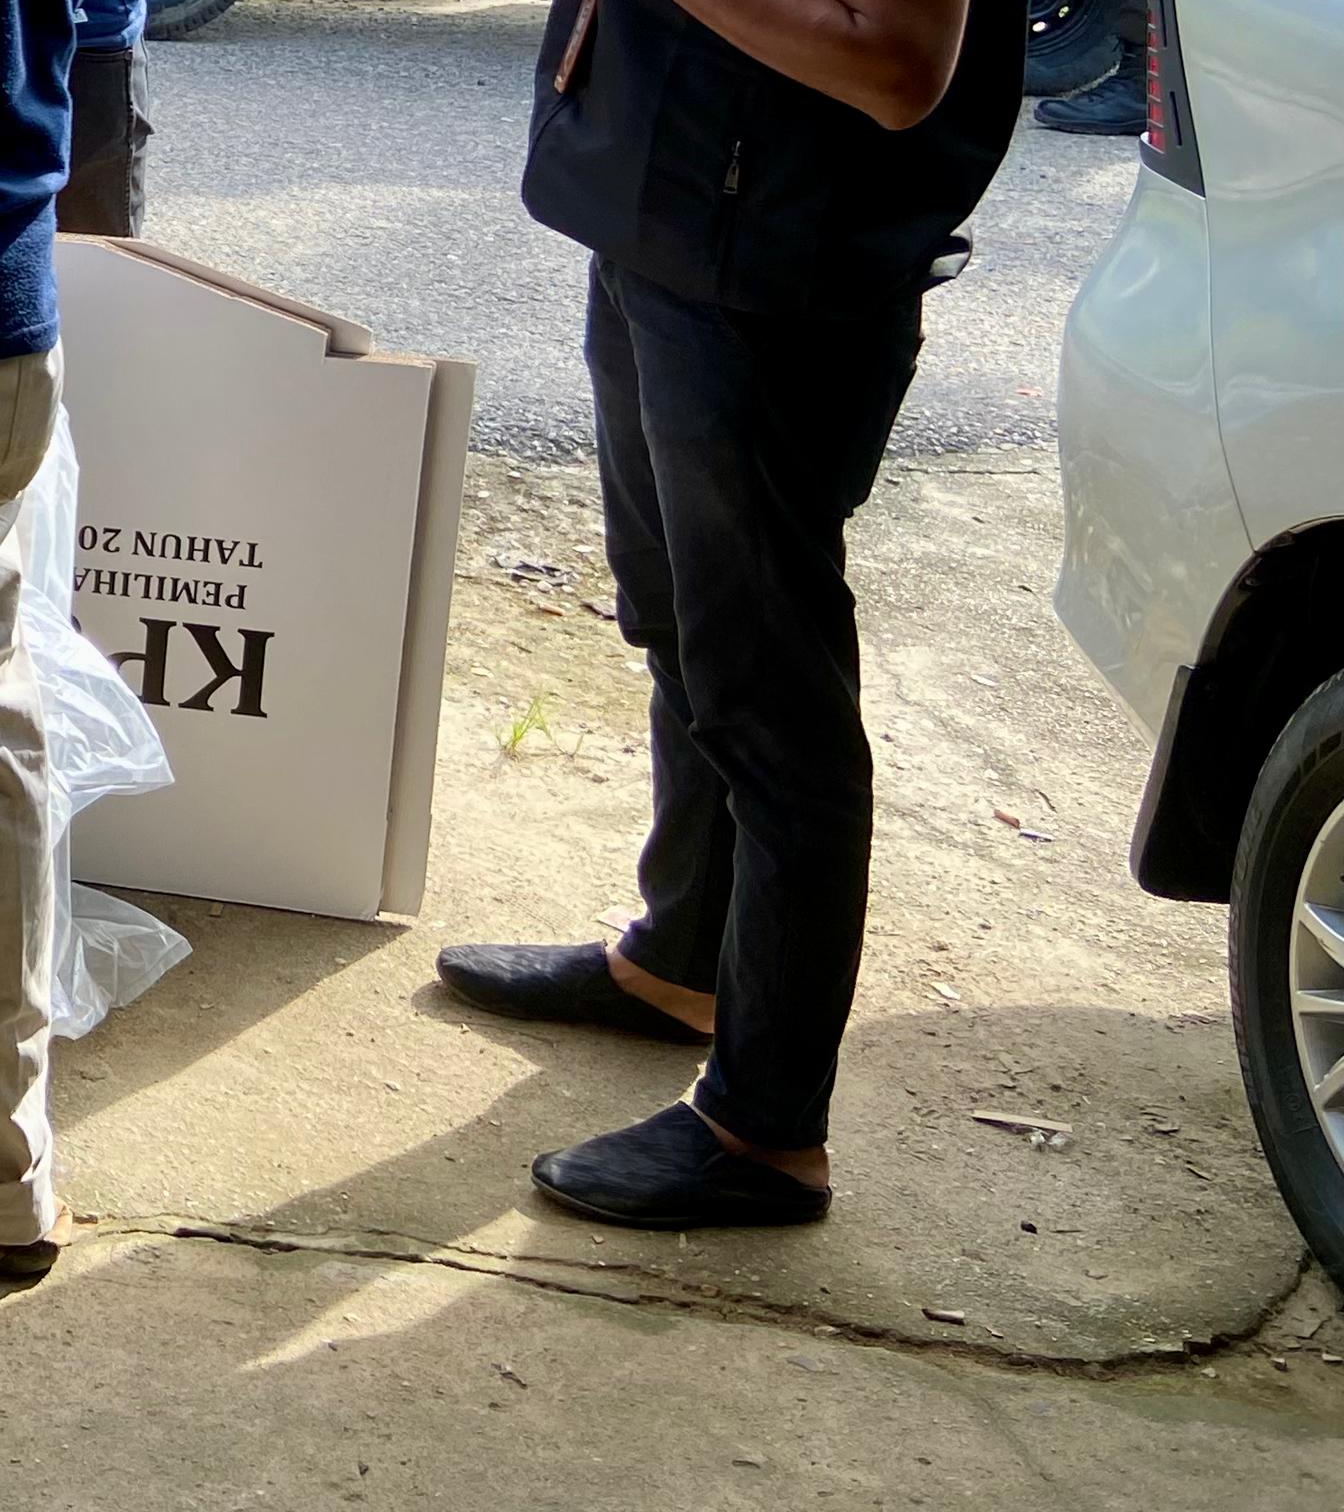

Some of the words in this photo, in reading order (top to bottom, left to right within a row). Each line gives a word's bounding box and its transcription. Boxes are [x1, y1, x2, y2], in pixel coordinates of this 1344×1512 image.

[78, 524, 122, 554] 20
[132, 530, 263, 569] TAHUN
[73, 566, 248, 610] PEMILIHA
[107, 616, 276, 719] KP
